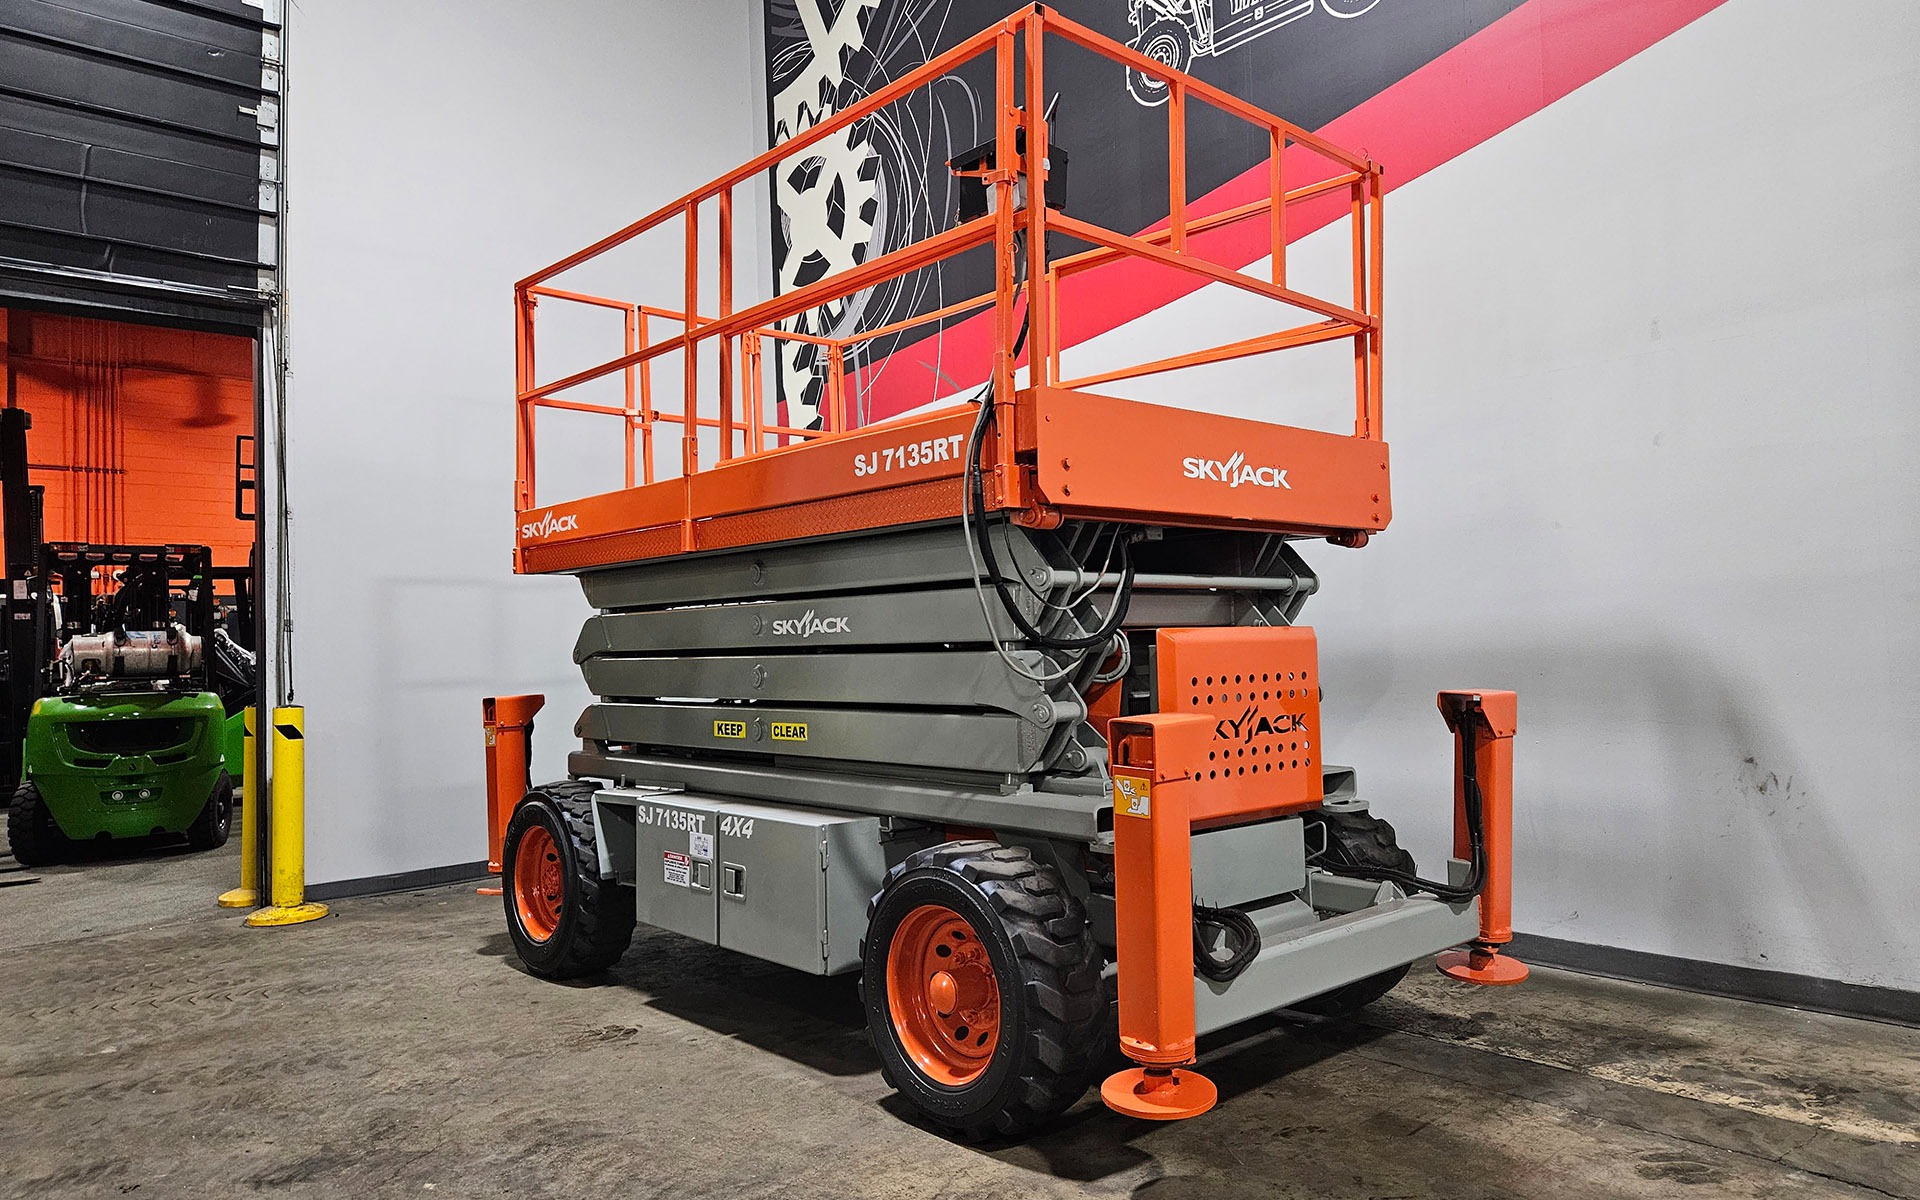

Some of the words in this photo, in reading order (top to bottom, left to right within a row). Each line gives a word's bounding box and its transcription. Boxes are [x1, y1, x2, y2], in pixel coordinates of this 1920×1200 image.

[854, 451, 878, 477] SJ
[882, 434, 964, 472] 7135RT
[1182, 450, 1292, 490] SKYJACK
[521, 510, 579, 539] SKYJACK
[772, 609, 851, 638] SKYJACK
[717, 722, 743, 736] KEEP
[773, 725, 806, 739] CLEAR
[1212, 704, 1309, 745] KYJACK
[638, 805, 653, 825] SJ
[656, 807, 706, 834] 7135RT
[720, 815, 755, 839] 4X4
